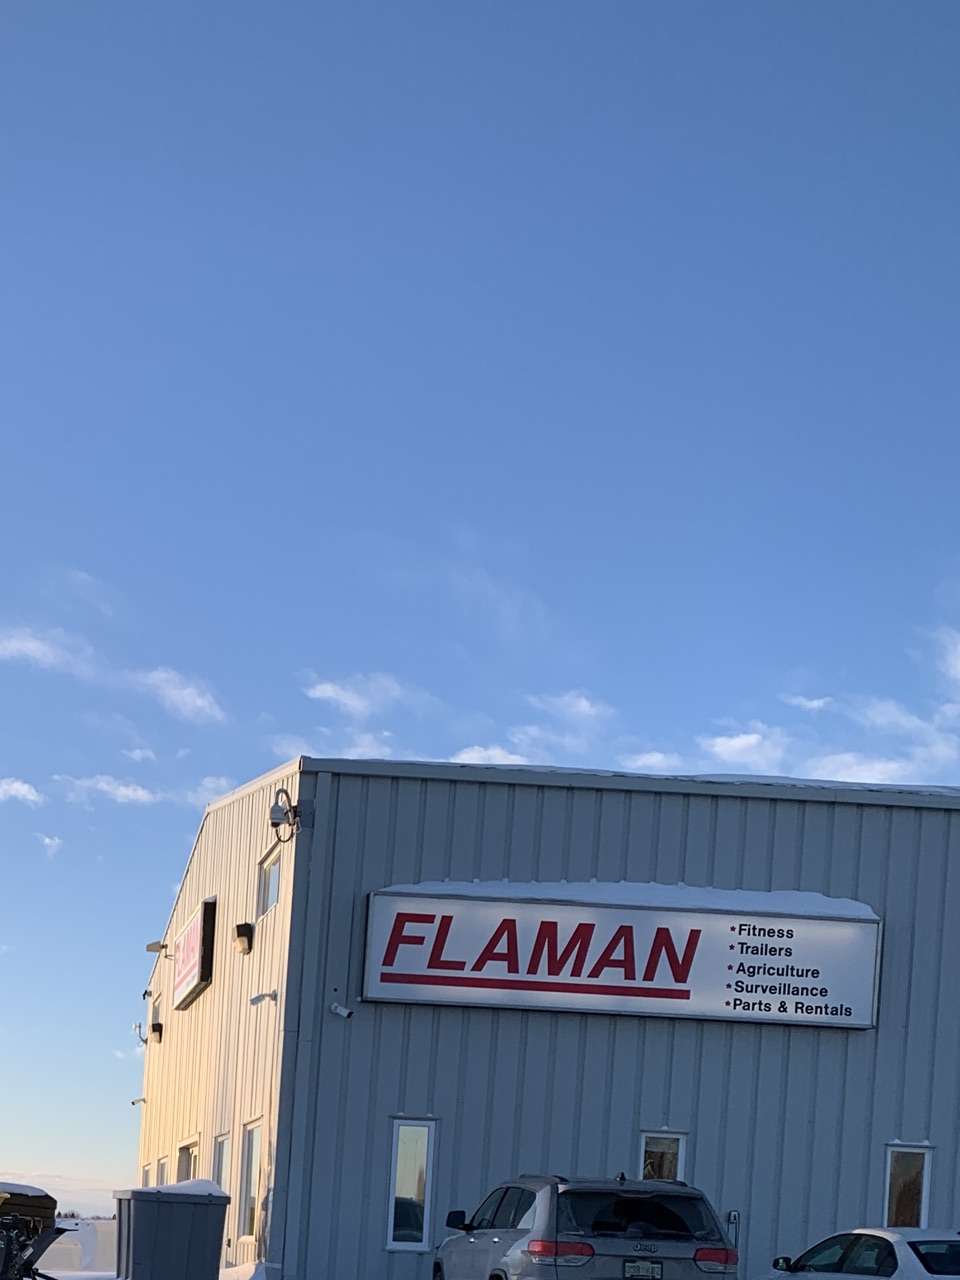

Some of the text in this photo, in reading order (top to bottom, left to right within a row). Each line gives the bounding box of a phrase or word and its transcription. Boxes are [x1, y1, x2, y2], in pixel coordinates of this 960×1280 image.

[738, 923, 794, 939] Fitness
[382, 912, 702, 983] FLAMAN
[738, 942, 793, 957] Trailers
[736, 962, 820, 978] Agriculture
[734, 980, 828, 997] Surveillance
[733, 998, 853, 1016] Parts & Rentals
